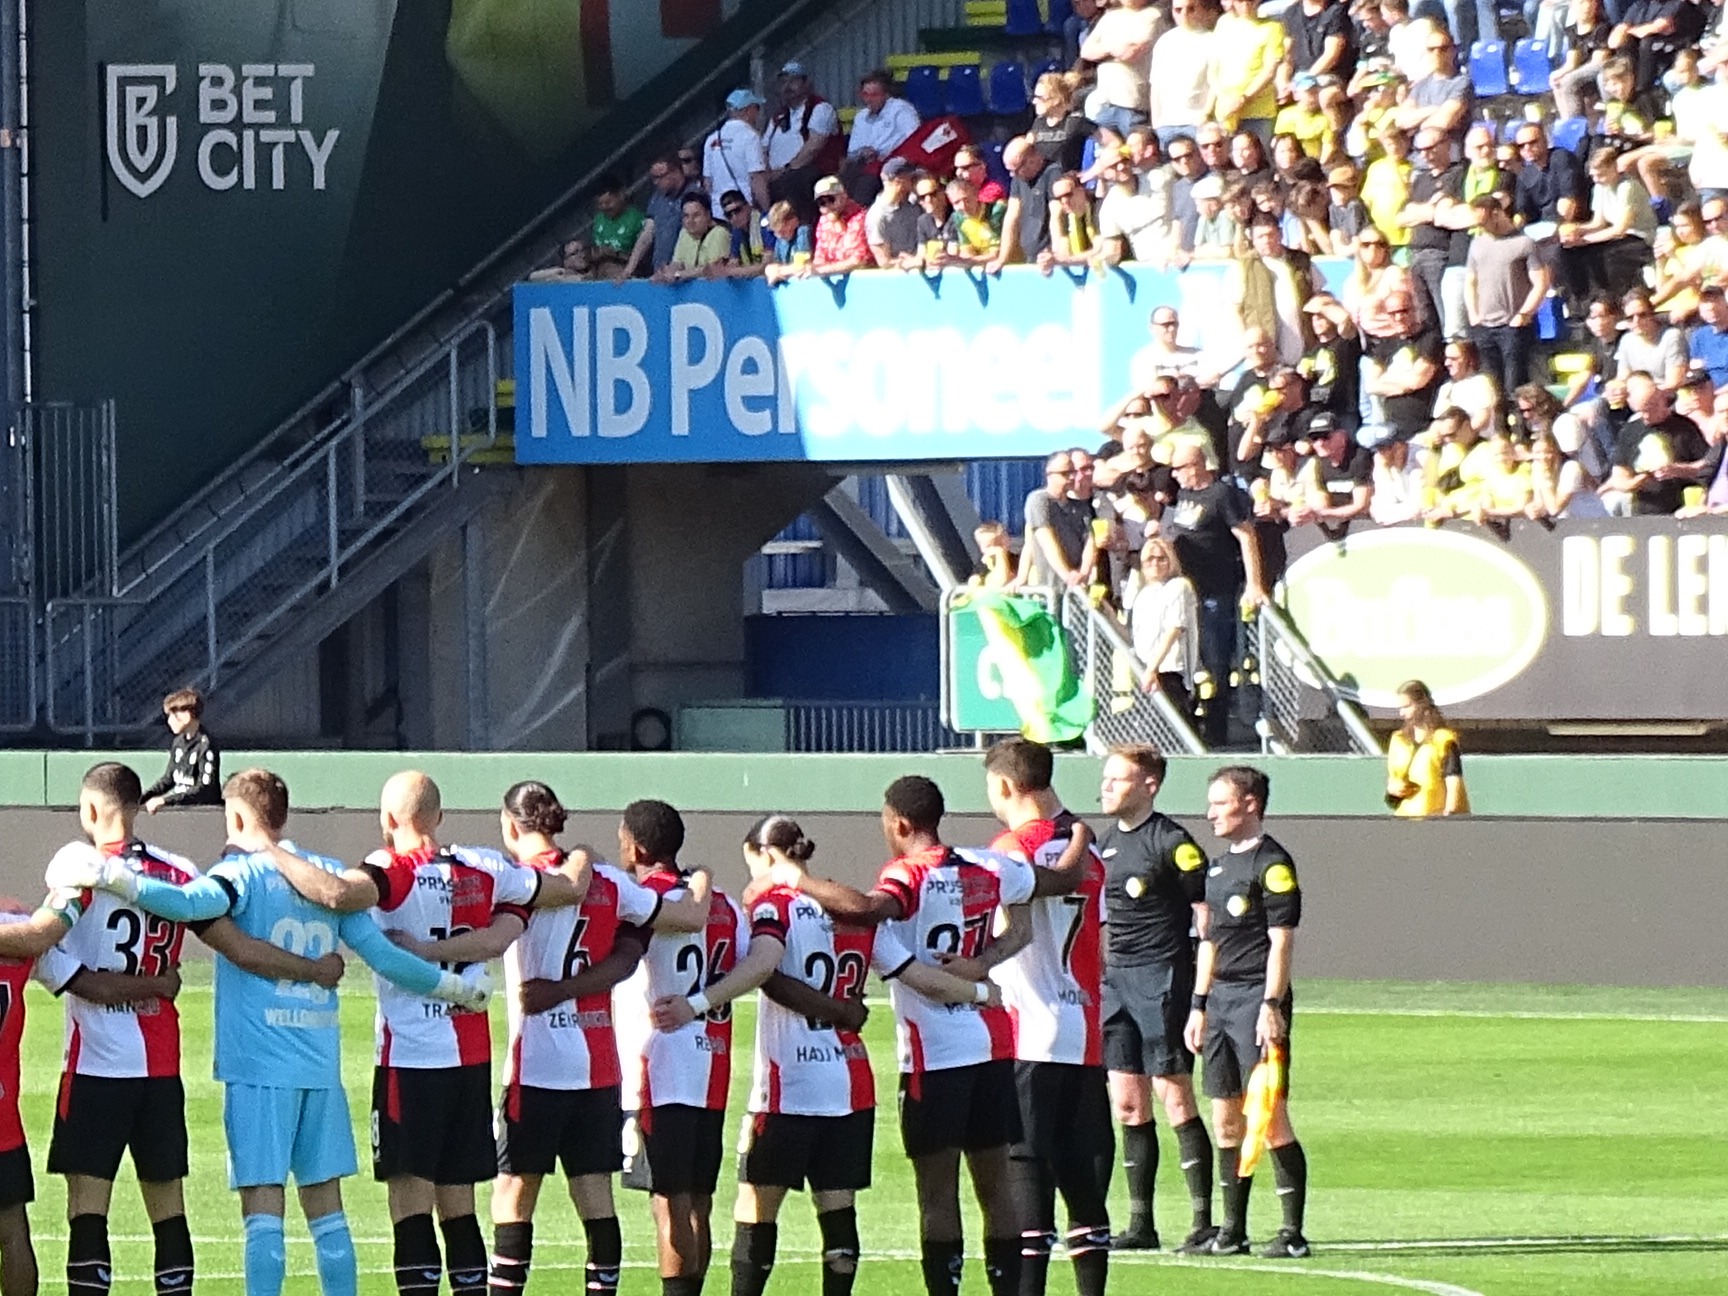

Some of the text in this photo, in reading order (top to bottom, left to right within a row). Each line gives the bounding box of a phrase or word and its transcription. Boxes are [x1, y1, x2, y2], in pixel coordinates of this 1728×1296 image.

[199, 63, 315, 125] BET
[197, 129, 340, 192] CITY
[528, 285, 1103, 439] NB Personeel
[1562, 534, 1635, 637] DE
[106, 908, 180, 977] 33
[1062, 894, 1089, 975] 7
